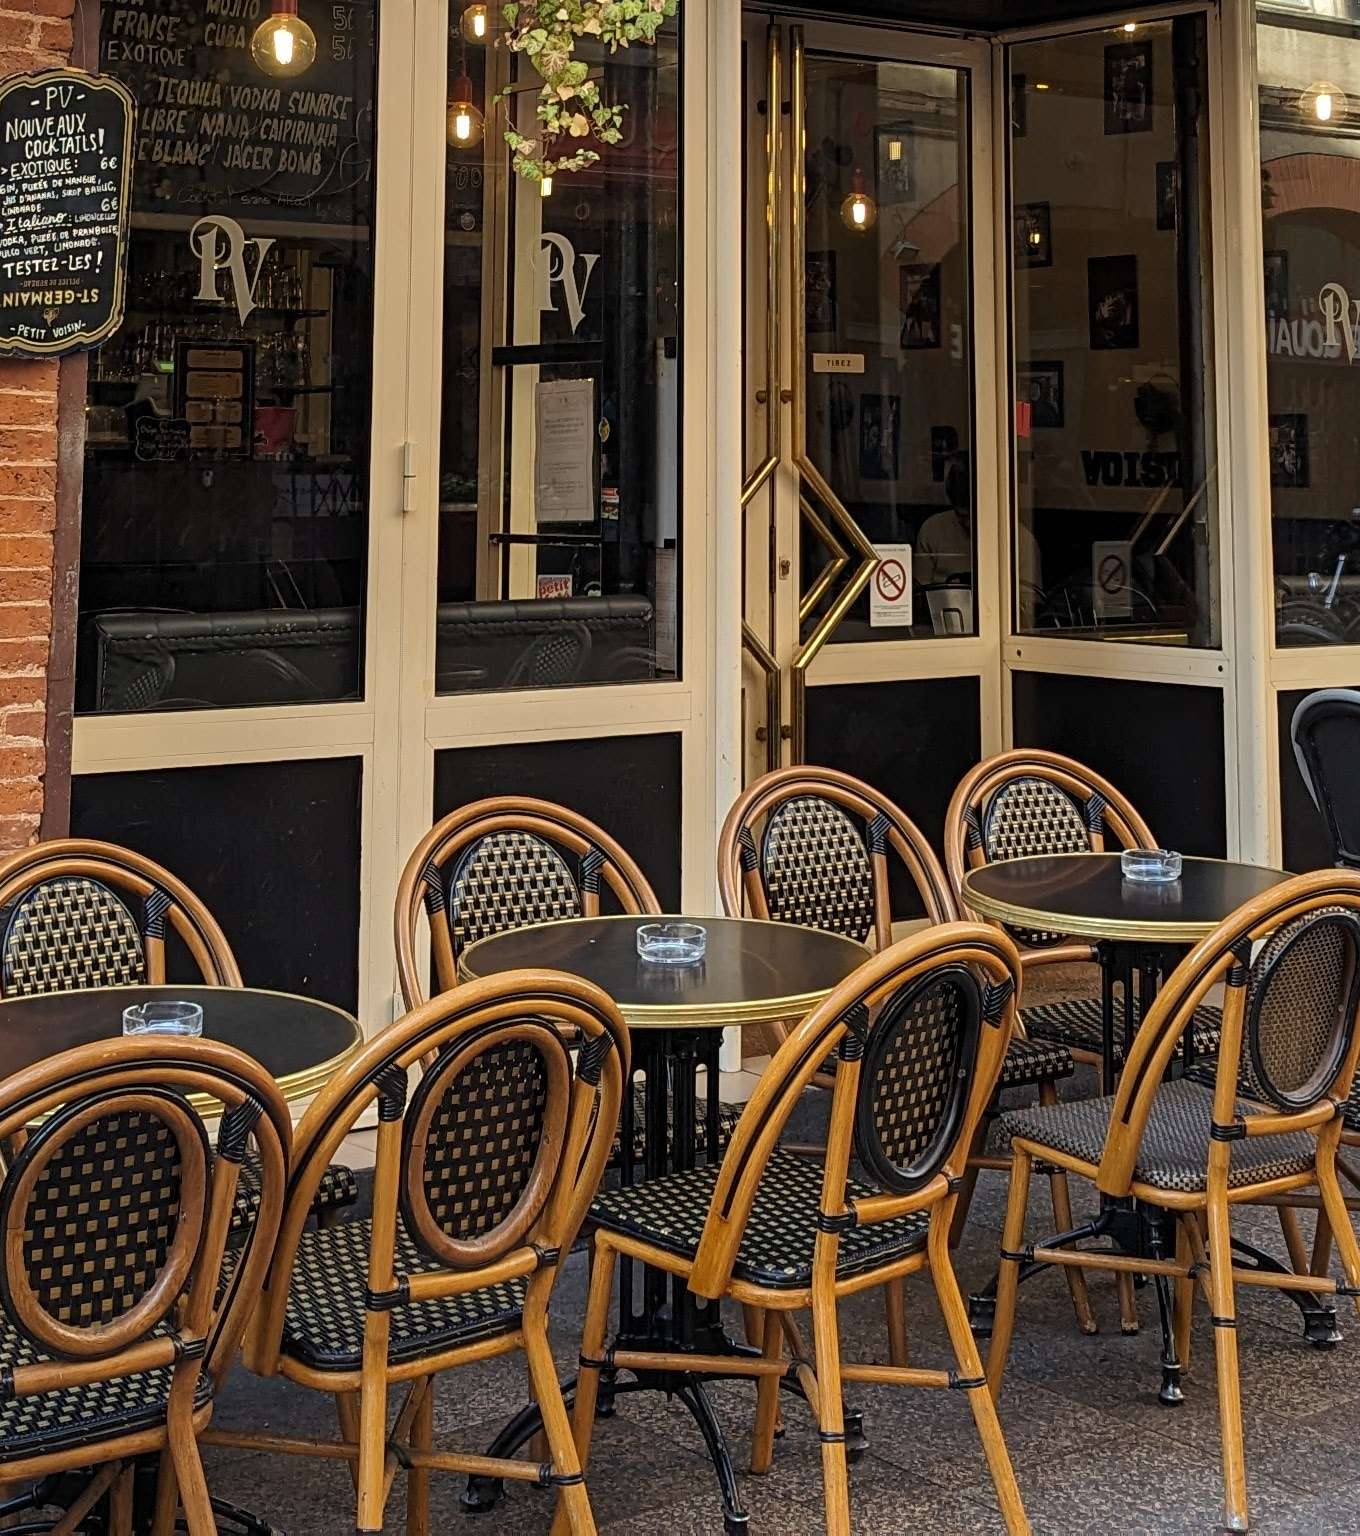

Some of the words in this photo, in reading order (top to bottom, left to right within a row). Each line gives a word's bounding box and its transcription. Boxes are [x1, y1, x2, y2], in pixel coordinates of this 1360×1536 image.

[112, 10, 181, 42] FRAISE
[205, 22, 246, 49] CUBA
[155, 75, 222, 108] TEQUILA
[230, 87, 281, 112] VODKA
[5, 113, 87, 143] NOUVEAUX
[141, 107, 188, 134] LIBRE
[200, 113, 249, 141] NANA
[100, 157, 117, 170] 6€
[279, 151, 322, 175] BOMB
[101, 197, 118, 211] 6€
[3, 289, 100, 308] ST-GERMAIN
